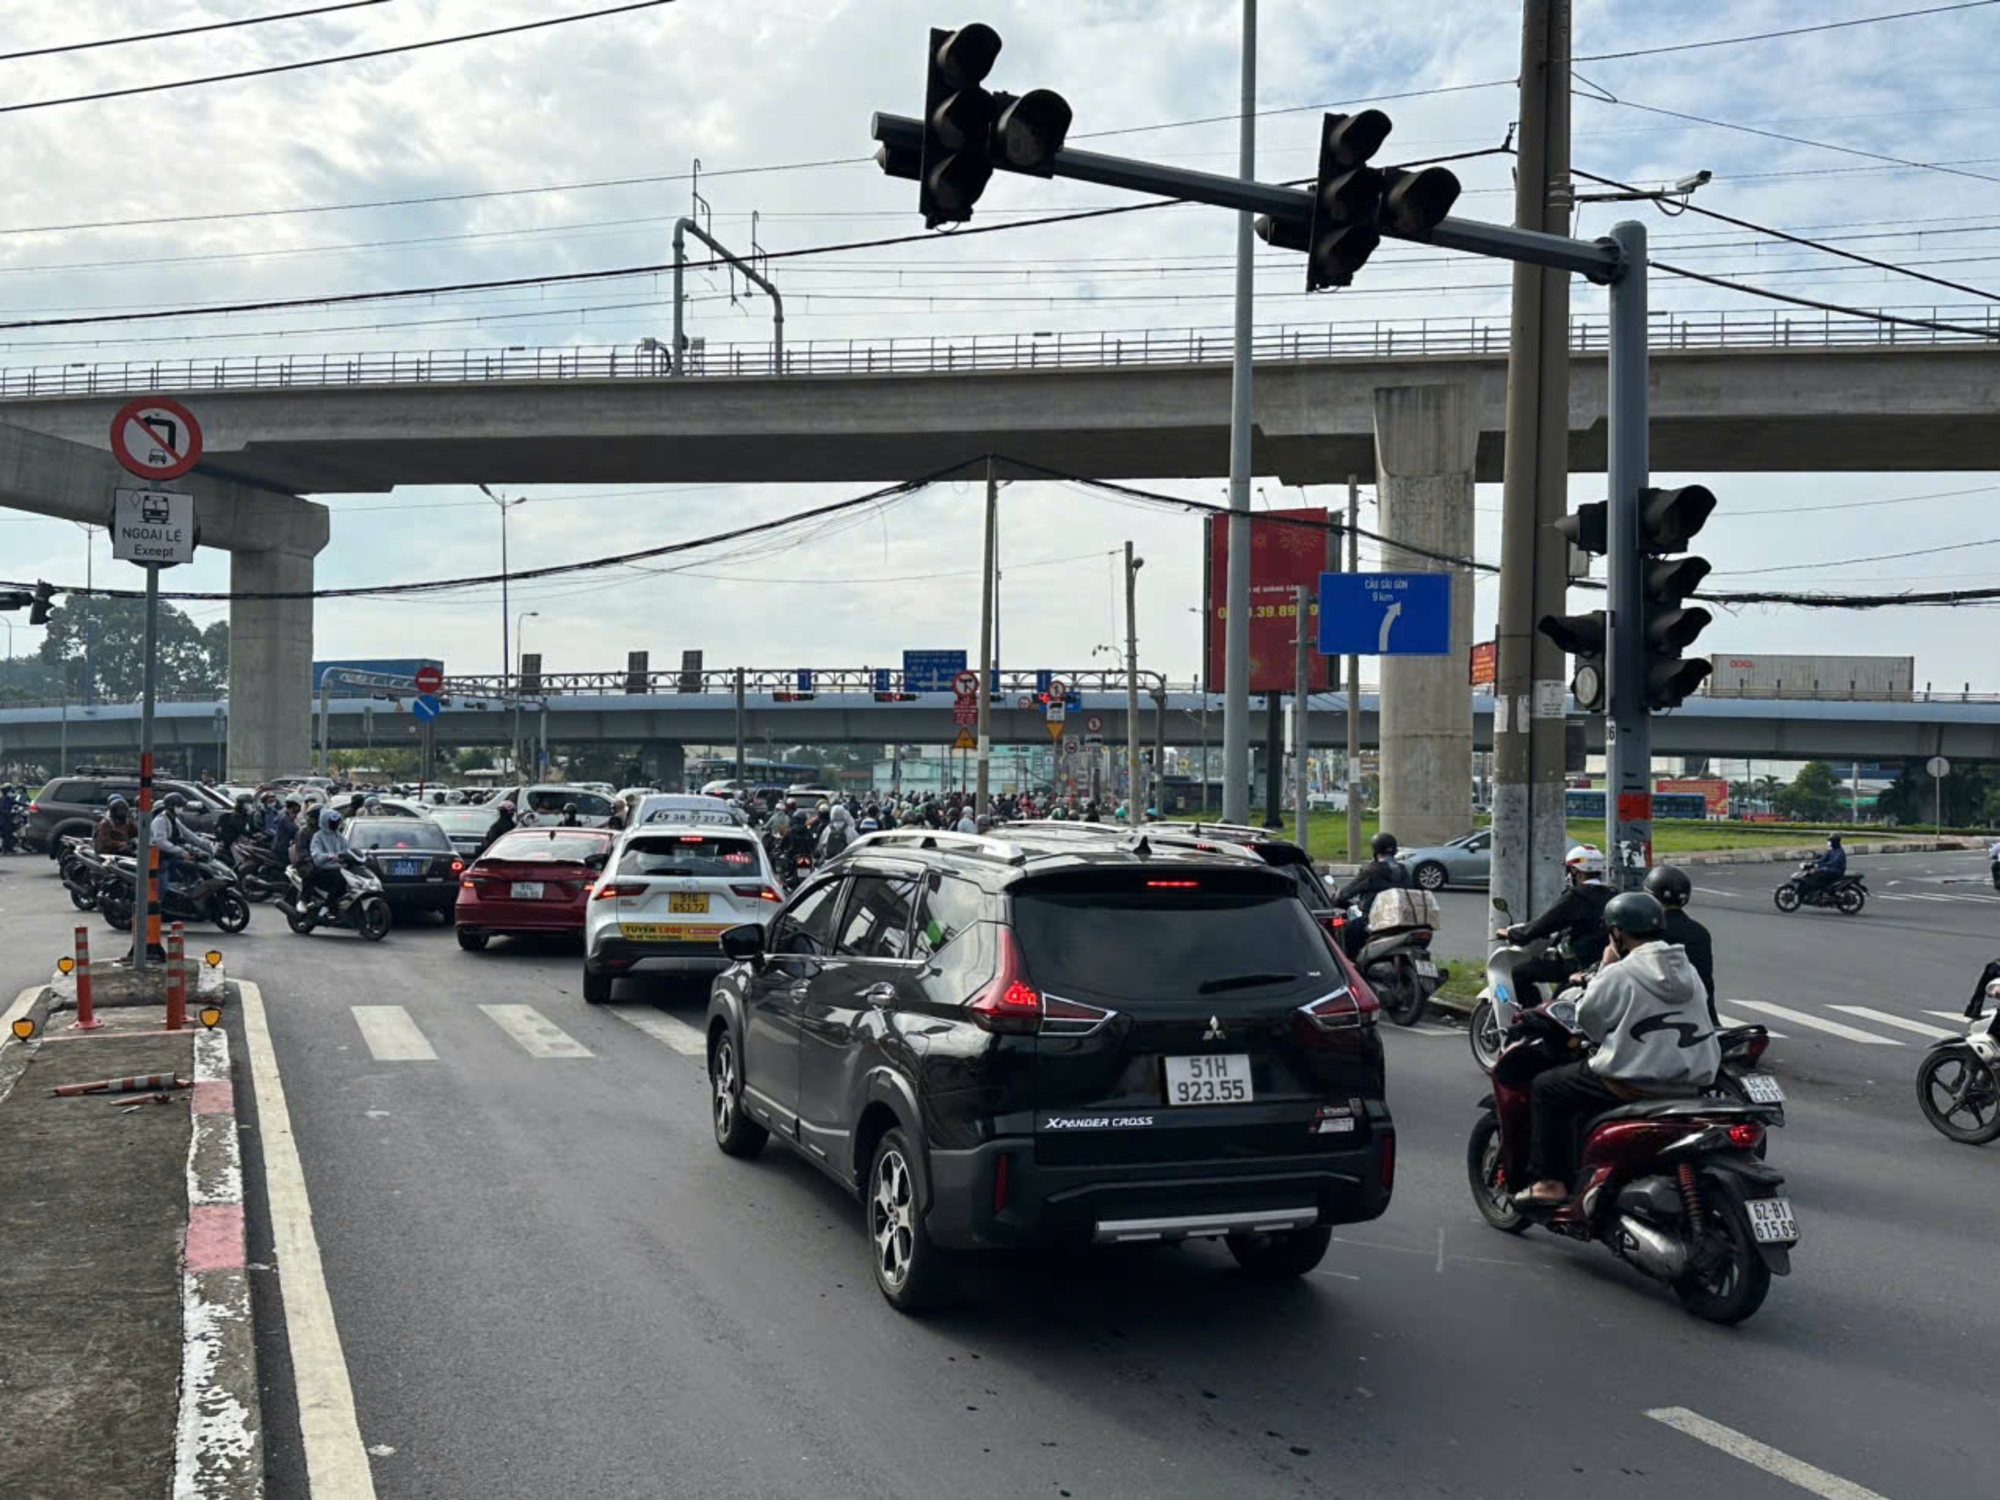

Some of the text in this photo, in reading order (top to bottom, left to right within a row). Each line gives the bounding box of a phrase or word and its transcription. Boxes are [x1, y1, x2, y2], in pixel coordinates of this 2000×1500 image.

[134, 544, 173, 558] Except
[1379, 591, 1394, 602] km
[1190, 1057, 1228, 1079] 51H
[1177, 1079, 1245, 1102] 923.55
[1044, 1116, 1153, 1129] XPANDER CROSS
[1753, 1202, 1788, 1220] 62-B1
